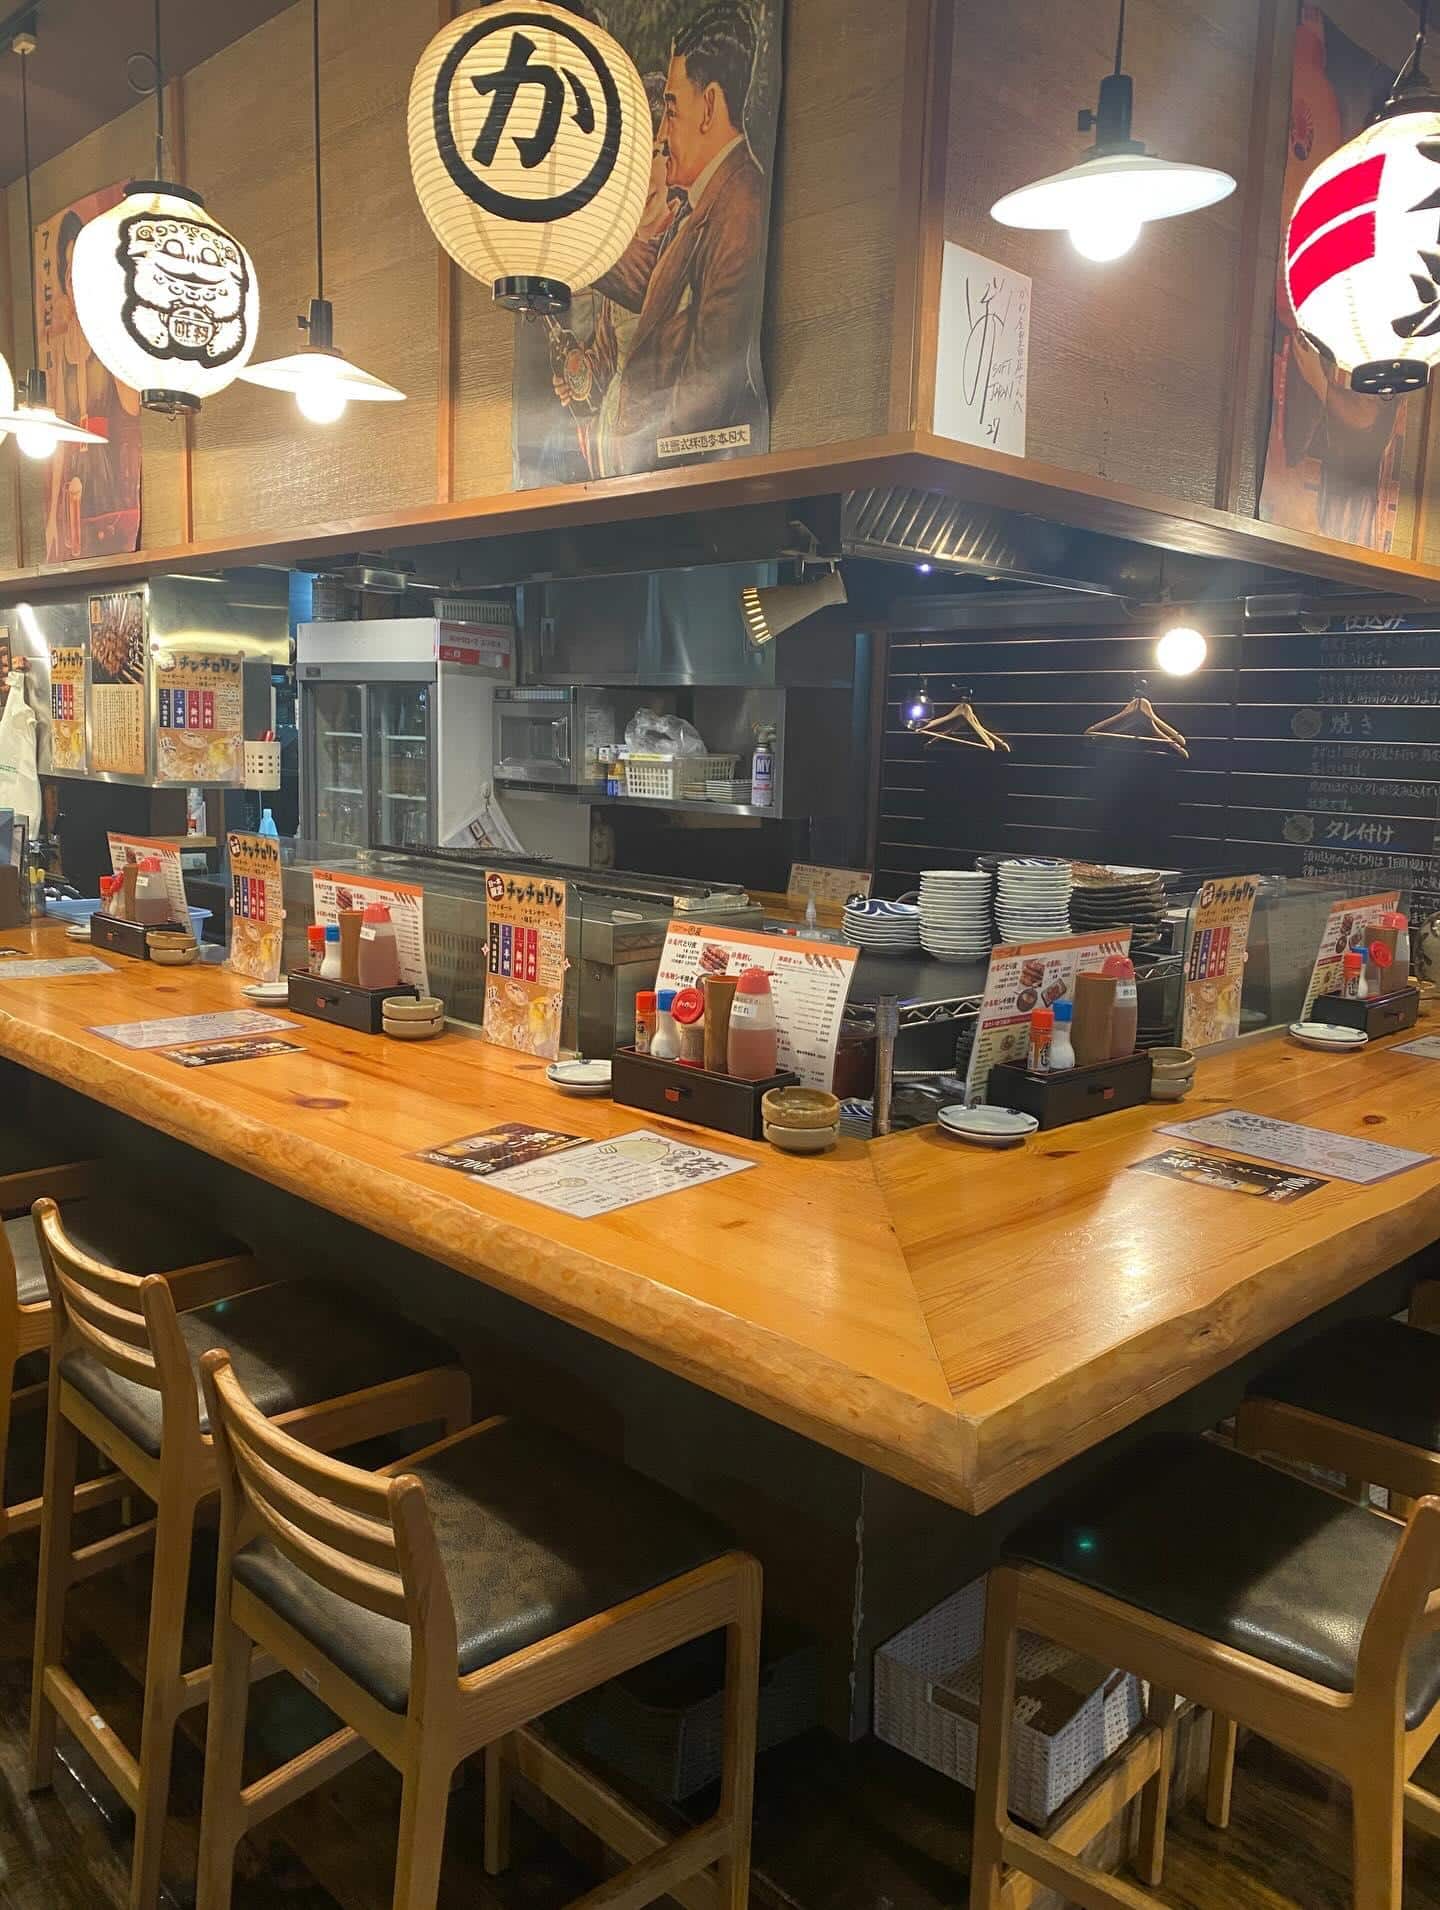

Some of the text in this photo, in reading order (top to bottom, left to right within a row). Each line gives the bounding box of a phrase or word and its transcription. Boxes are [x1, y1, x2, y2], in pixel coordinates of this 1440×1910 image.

[470, 31, 595, 170] か
[179, 655, 241, 673] チンチロリン
[756, 759, 771, 773] MY
[1327, 820, 1395, 845] タレ付け
[506, 879, 563, 908] チンチロリン
